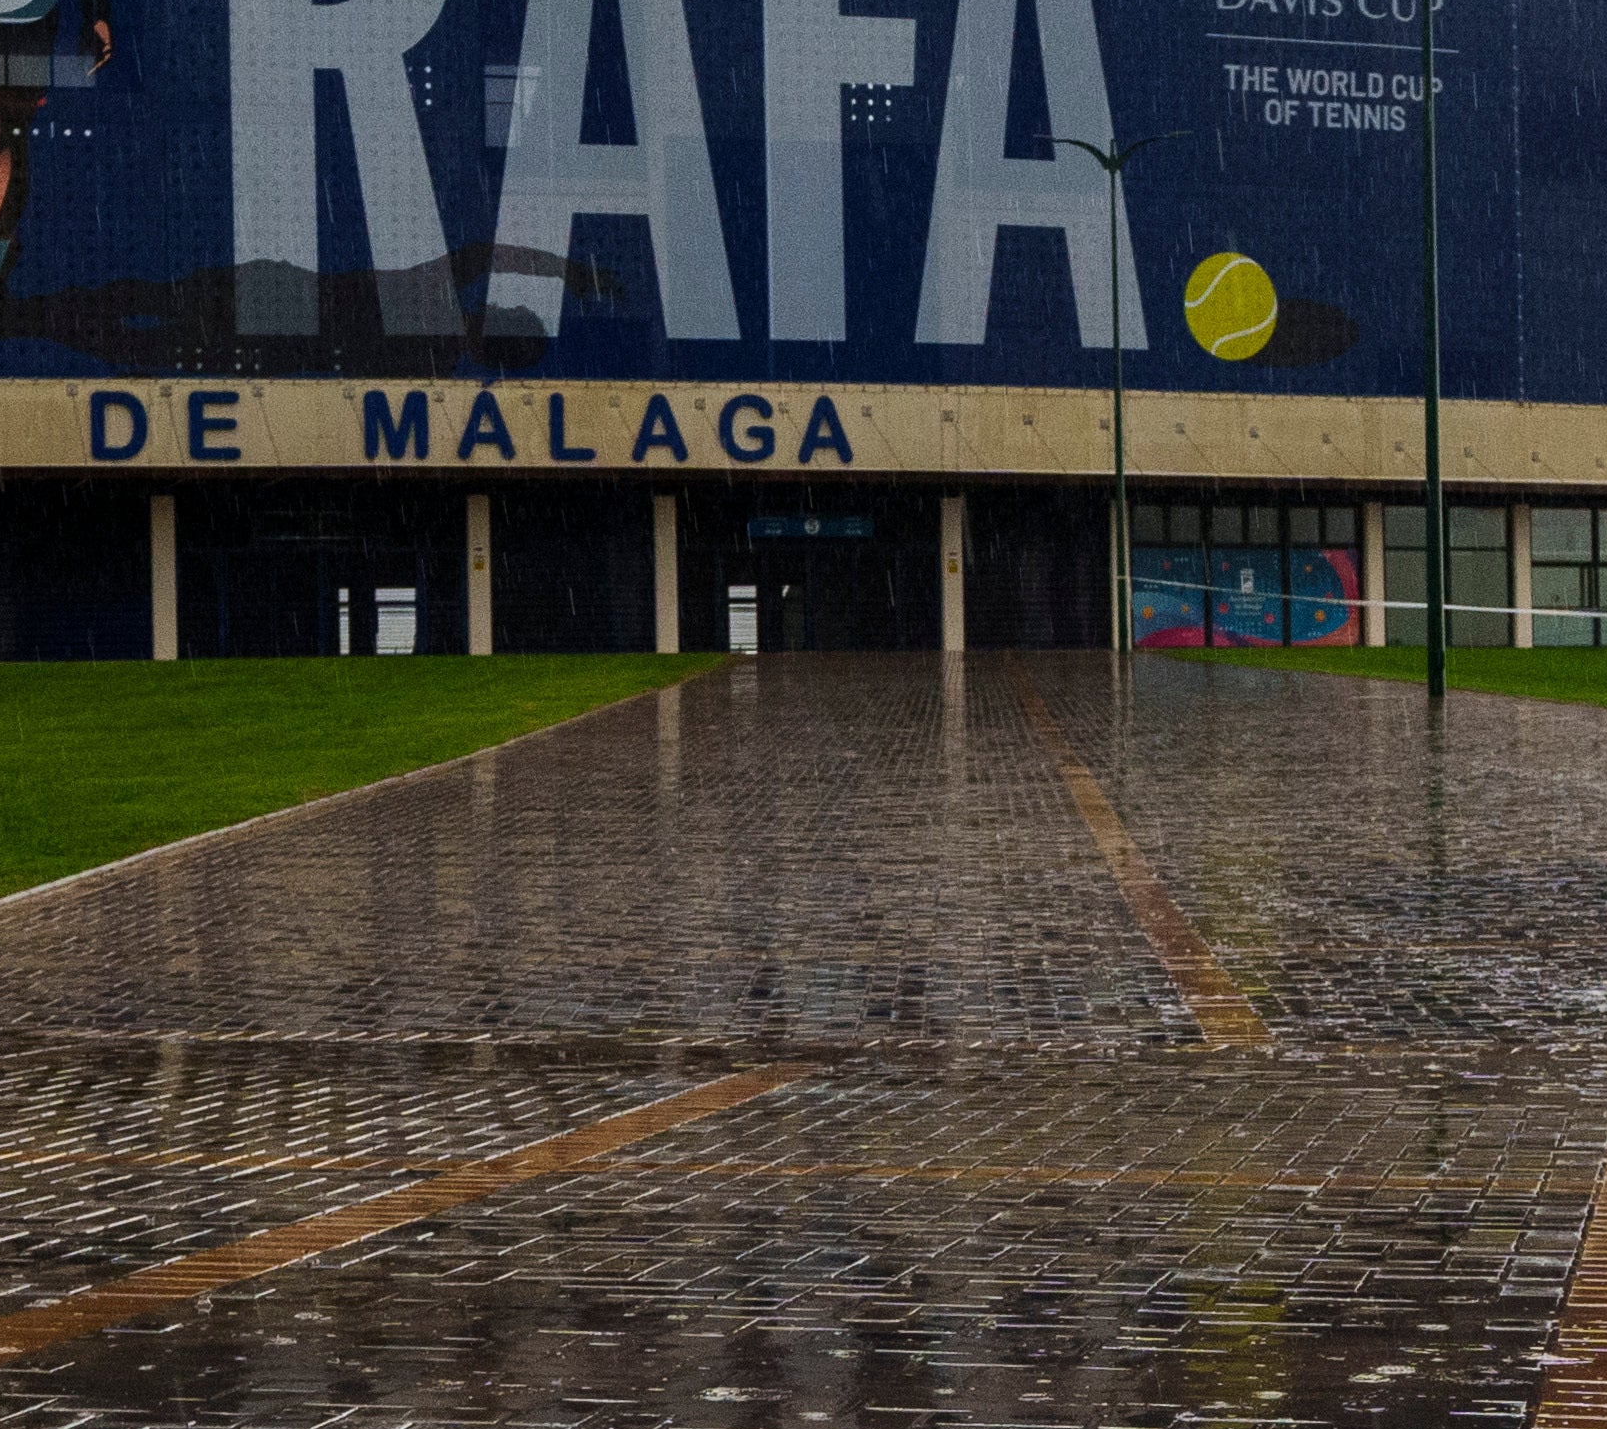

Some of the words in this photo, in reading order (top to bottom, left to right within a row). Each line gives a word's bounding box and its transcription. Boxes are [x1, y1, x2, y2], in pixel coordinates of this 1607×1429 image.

[1224, 64, 1279, 94] THE
[1286, 68, 1384, 99] WORLD
[1264, 100, 1298, 126] OF
[1308, 102, 1406, 131] TENNIS
[89, 390, 242, 463] DE
[364, 378, 854, 463] MÁLAGA
